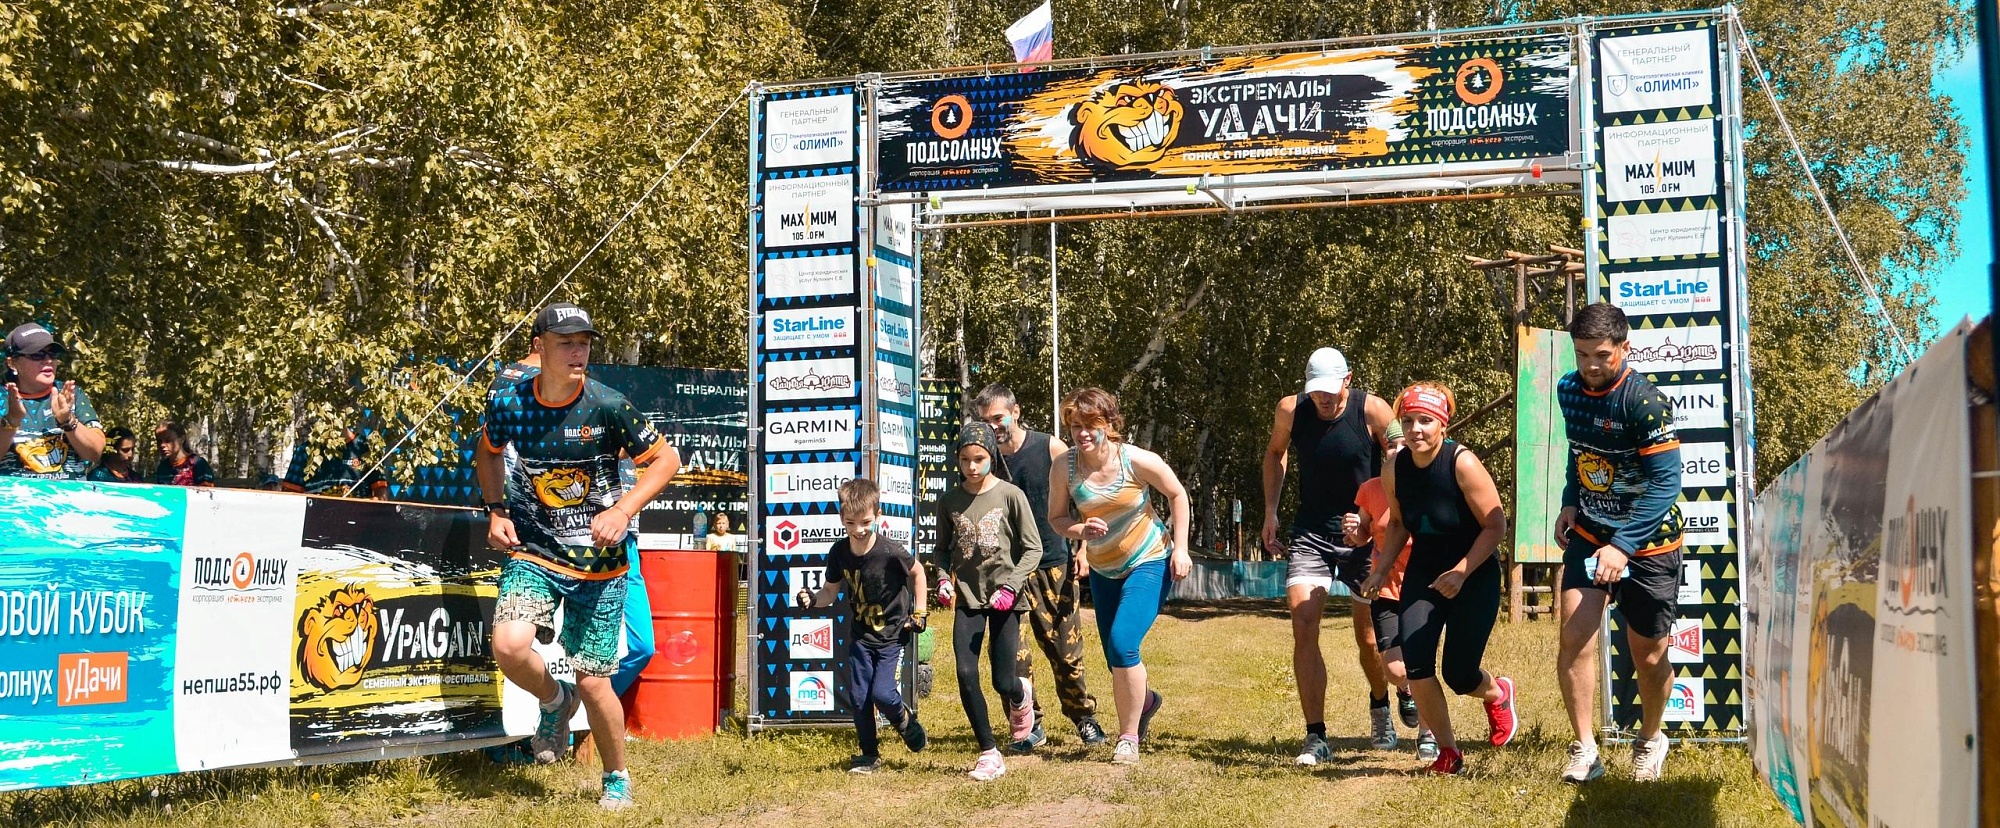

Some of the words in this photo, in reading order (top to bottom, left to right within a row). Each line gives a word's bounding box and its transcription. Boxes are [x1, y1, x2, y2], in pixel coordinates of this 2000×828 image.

[1617, 43, 1691, 57] ГЕНЕРАЛЬНЫЙ
[1632, 54, 1677, 65] ПАРТНЕР
[1190, 78, 1332, 104] ЭКСТРЕМАЛЫ
[1635, 78, 1700, 93] «ОЛИМП»
[780, 106, 839, 119] ГЕНЕРАЛЬНЫЙ
[1426, 102, 1538, 131] ПОДСОЛНУХ
[791, 116, 828, 126] ПАРТНЕР
[1198, 101, 1322, 141] УДАЧИ
[1608, 125, 1709, 139] ИНФОРМАЦИОННЫЙ
[793, 136, 844, 151] «ОЛИМП»
[1637, 137, 1681, 147] ПАРТНЕР
[906, 136, 1003, 164] ПОДСОЛНУХ
[1182, 151, 1220, 162] ГОНКА
[1223, 149, 1232, 160] С
[1233, 144, 1338, 160] ПРЕПЯТСТВИЯМИ
[768, 179, 850, 192] ИНФОРМАЦИОННЫЙ
[791, 190, 827, 199] ПАРТНЕР
[1619, 279, 1709, 298] StarLine
[1619, 299, 1659, 308] ЗАЩИЩАЕТ
[773, 316, 845, 333] StarLine
[676, 383, 748, 397] ГЕНЕРАЛЬН
[769, 419, 848, 434] GARMIN
[919, 454, 947, 463] РТНЕР
[717, 501, 727, 511] С
[1700, 516, 1719, 527] UP
[801, 528, 832, 538] RAVE
[194, 552, 288, 589] ПОДСОЛНУХ
[69, 590, 147, 635] КУБОК
[183, 670, 282, 695] непша55.рф
[363, 675, 407, 690] СЕМЕЙНЫЙ
